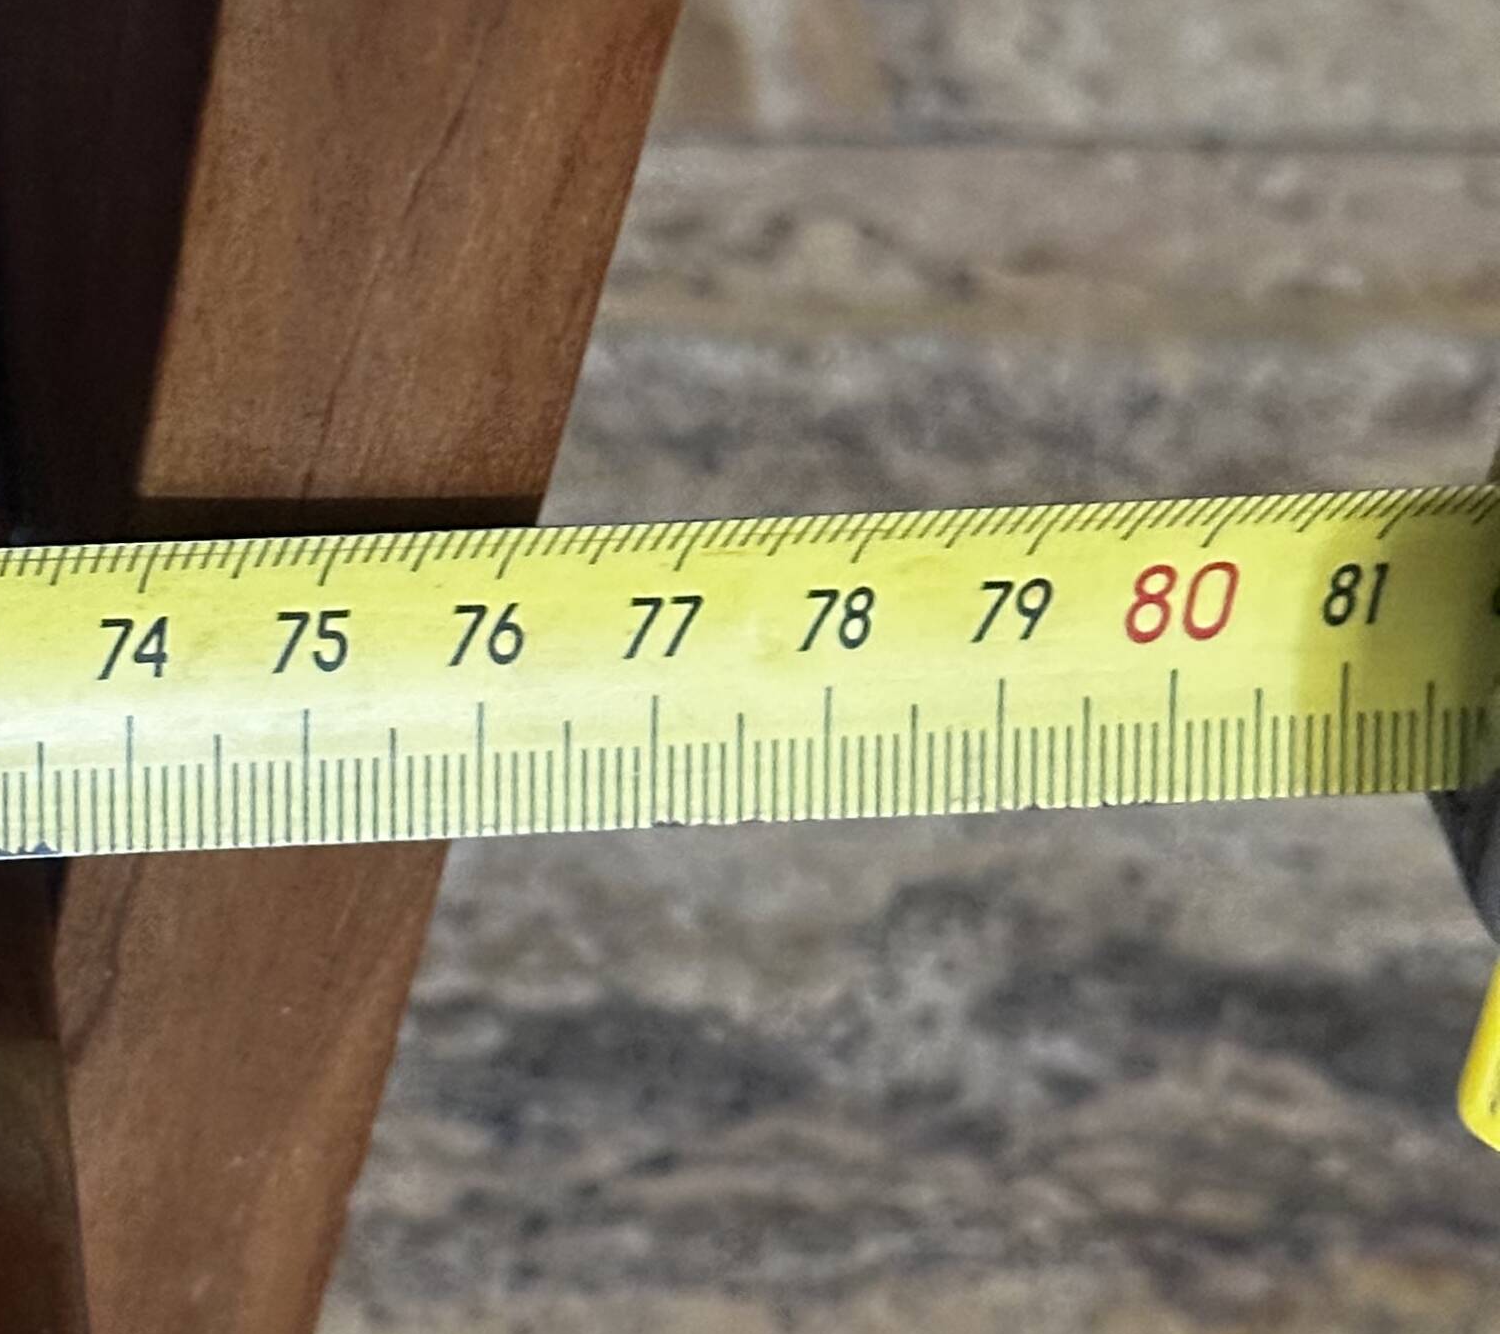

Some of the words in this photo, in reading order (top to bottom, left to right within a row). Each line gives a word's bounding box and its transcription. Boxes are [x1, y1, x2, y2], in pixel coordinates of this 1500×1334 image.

[97, 616, 169, 680] 74
[272, 609, 351, 673] 75
[448, 602, 525, 667] 76
[622, 594, 705, 660] 77
[797, 586, 876, 652] 78
[970, 578, 1053, 643] 79
[1125, 561, 1239, 644] 80
[1323, 562, 1390, 627] 81
